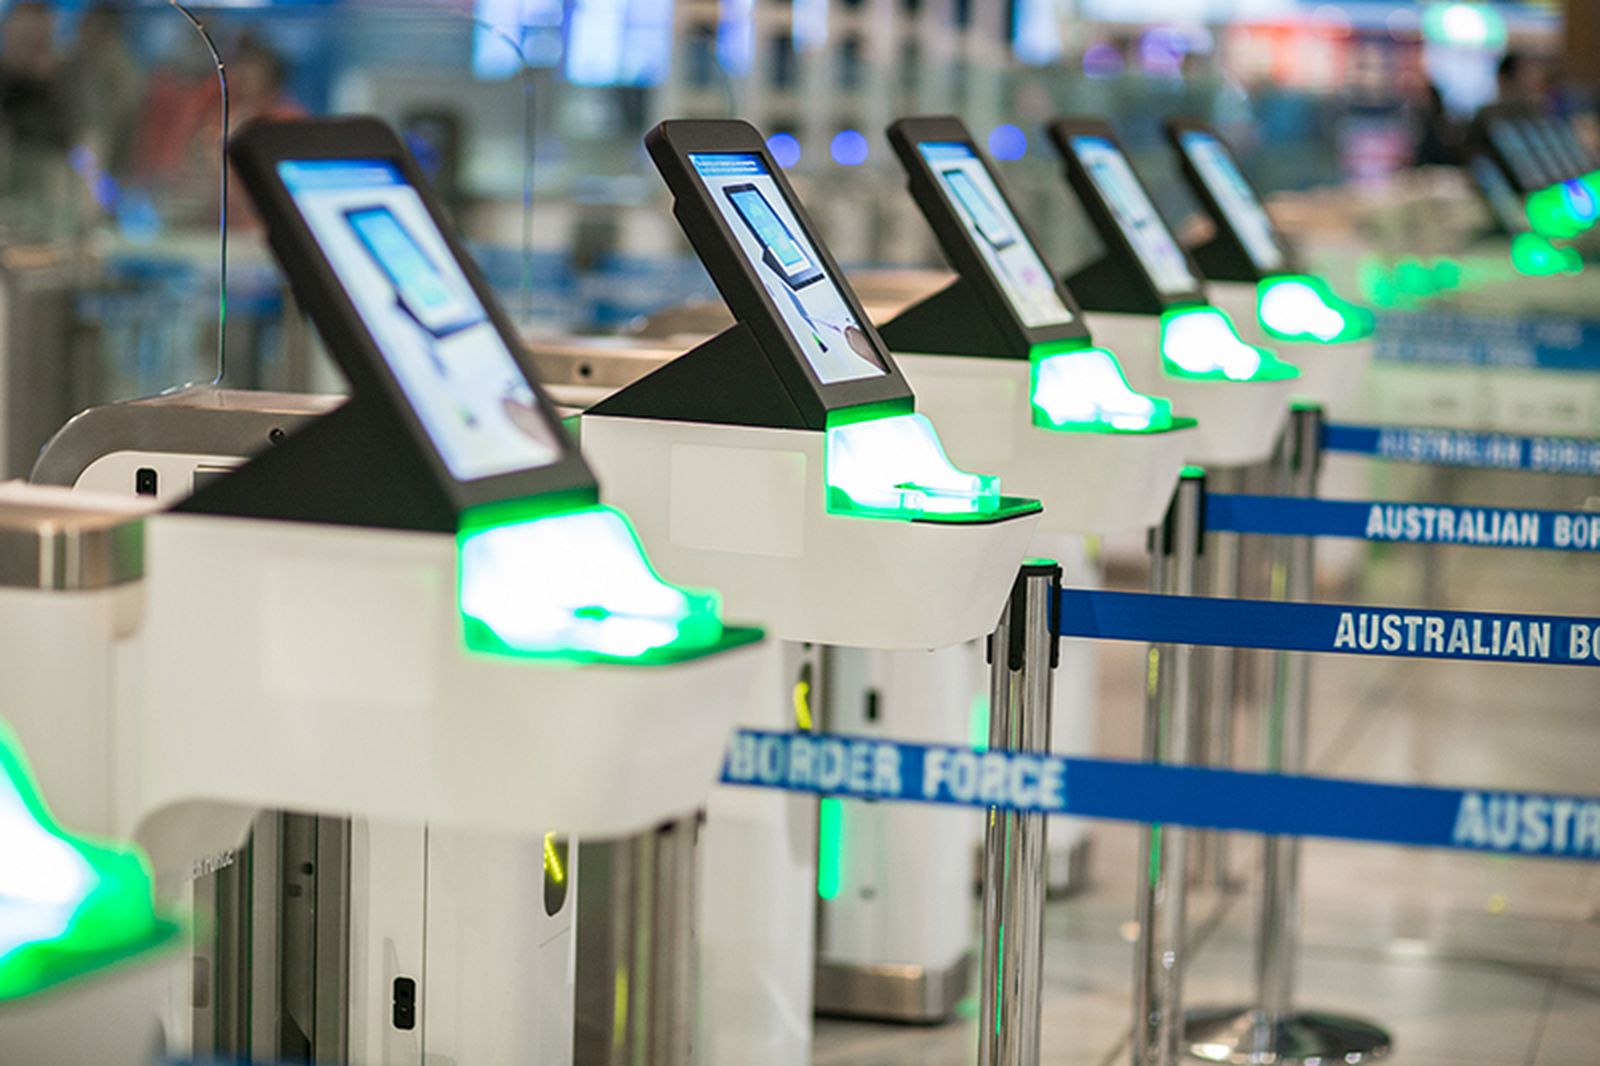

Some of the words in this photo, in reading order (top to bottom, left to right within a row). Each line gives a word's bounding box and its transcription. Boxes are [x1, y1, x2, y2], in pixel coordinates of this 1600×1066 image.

[1366, 504, 1539, 546] AUSTRALIAN
[1333, 612, 1551, 658] AUSTRALIAN
[729, 733, 899, 794] BORDER
[922, 748, 1066, 806] FORCE
